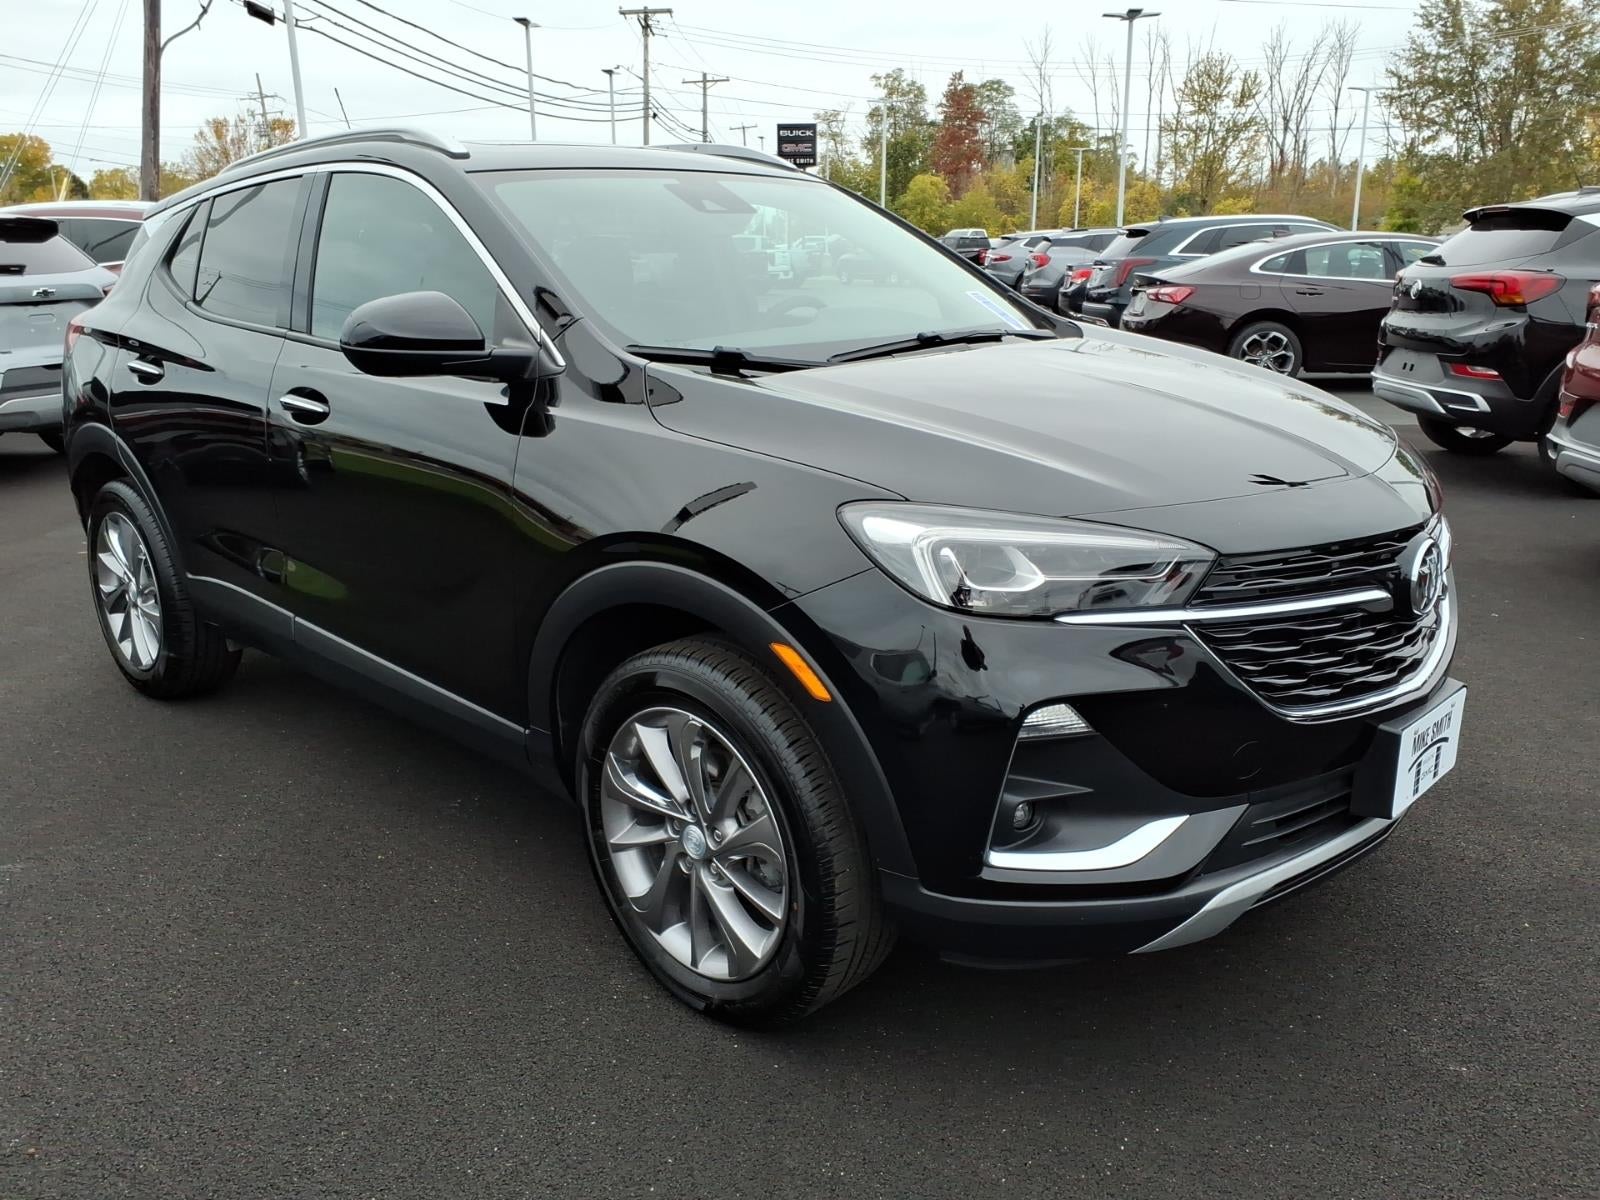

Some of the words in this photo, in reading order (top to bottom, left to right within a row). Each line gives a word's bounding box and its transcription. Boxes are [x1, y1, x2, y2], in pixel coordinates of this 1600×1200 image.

[782, 143, 812, 152] GMC
[1412, 726, 1431, 757] MIKE
[1431, 710, 1453, 742] SMITH
